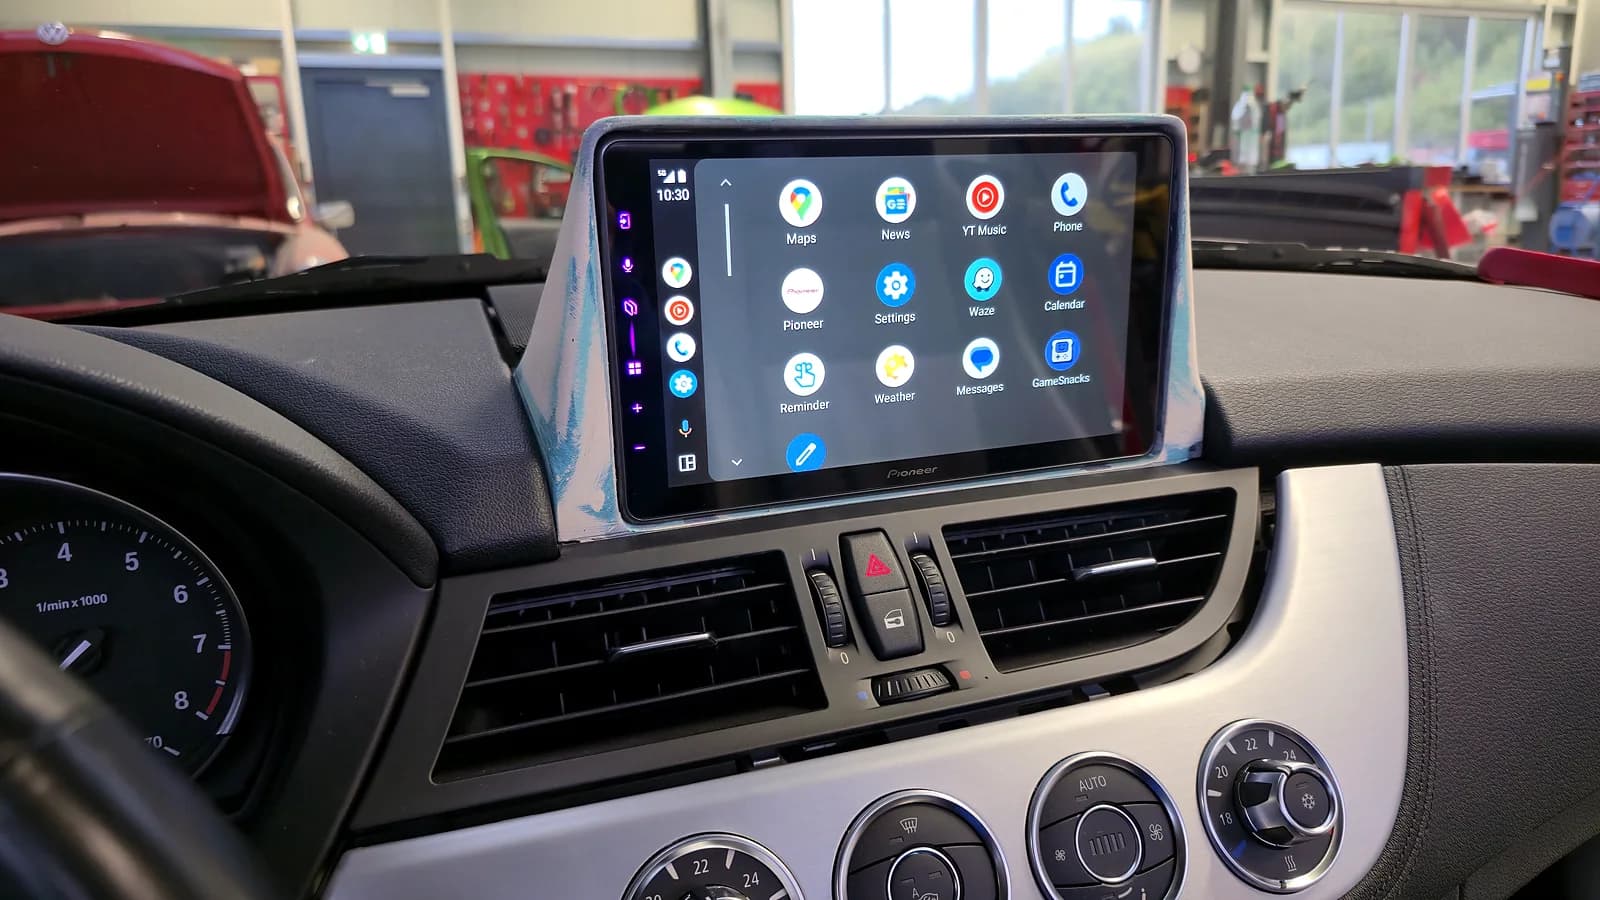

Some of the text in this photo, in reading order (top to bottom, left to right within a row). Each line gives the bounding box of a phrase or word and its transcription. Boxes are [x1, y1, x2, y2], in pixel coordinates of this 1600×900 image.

[656, 189, 690, 201] 10:30
[962, 224, 1007, 237] YT Music
[1053, 221, 1083, 232] Phone
[786, 233, 817, 247] Maps
[881, 229, 911, 241] News
[968, 306, 995, 317] Waze
[1044, 300, 1085, 311] Calendar
[783, 318, 824, 331] Pioneer
[874, 312, 916, 325] Settings
[1032, 373, 1091, 388] GameSnacks
[956, 382, 1004, 396] Messages
[874, 391, 916, 404] Weather
[780, 400, 830, 413] Reminder
[887, 466, 938, 479] Pioneer
[57, 542, 72, 562] 4
[125, 552, 139, 571] 5
[173, 585, 189, 604] 6
[36, 594, 108, 613] 1/min x 1000
[193, 634, 207, 653] 7
[174, 691, 190, 710] 8
[1245, 738, 1258, 751] 22
[1283, 750, 1297, 761] 24
[1216, 765, 1229, 779] 20
[1079, 776, 1107, 792] AUTO
[1219, 812, 1233, 826] 18
[693, 859, 710, 875] 22
[743, 872, 760, 888] 24
